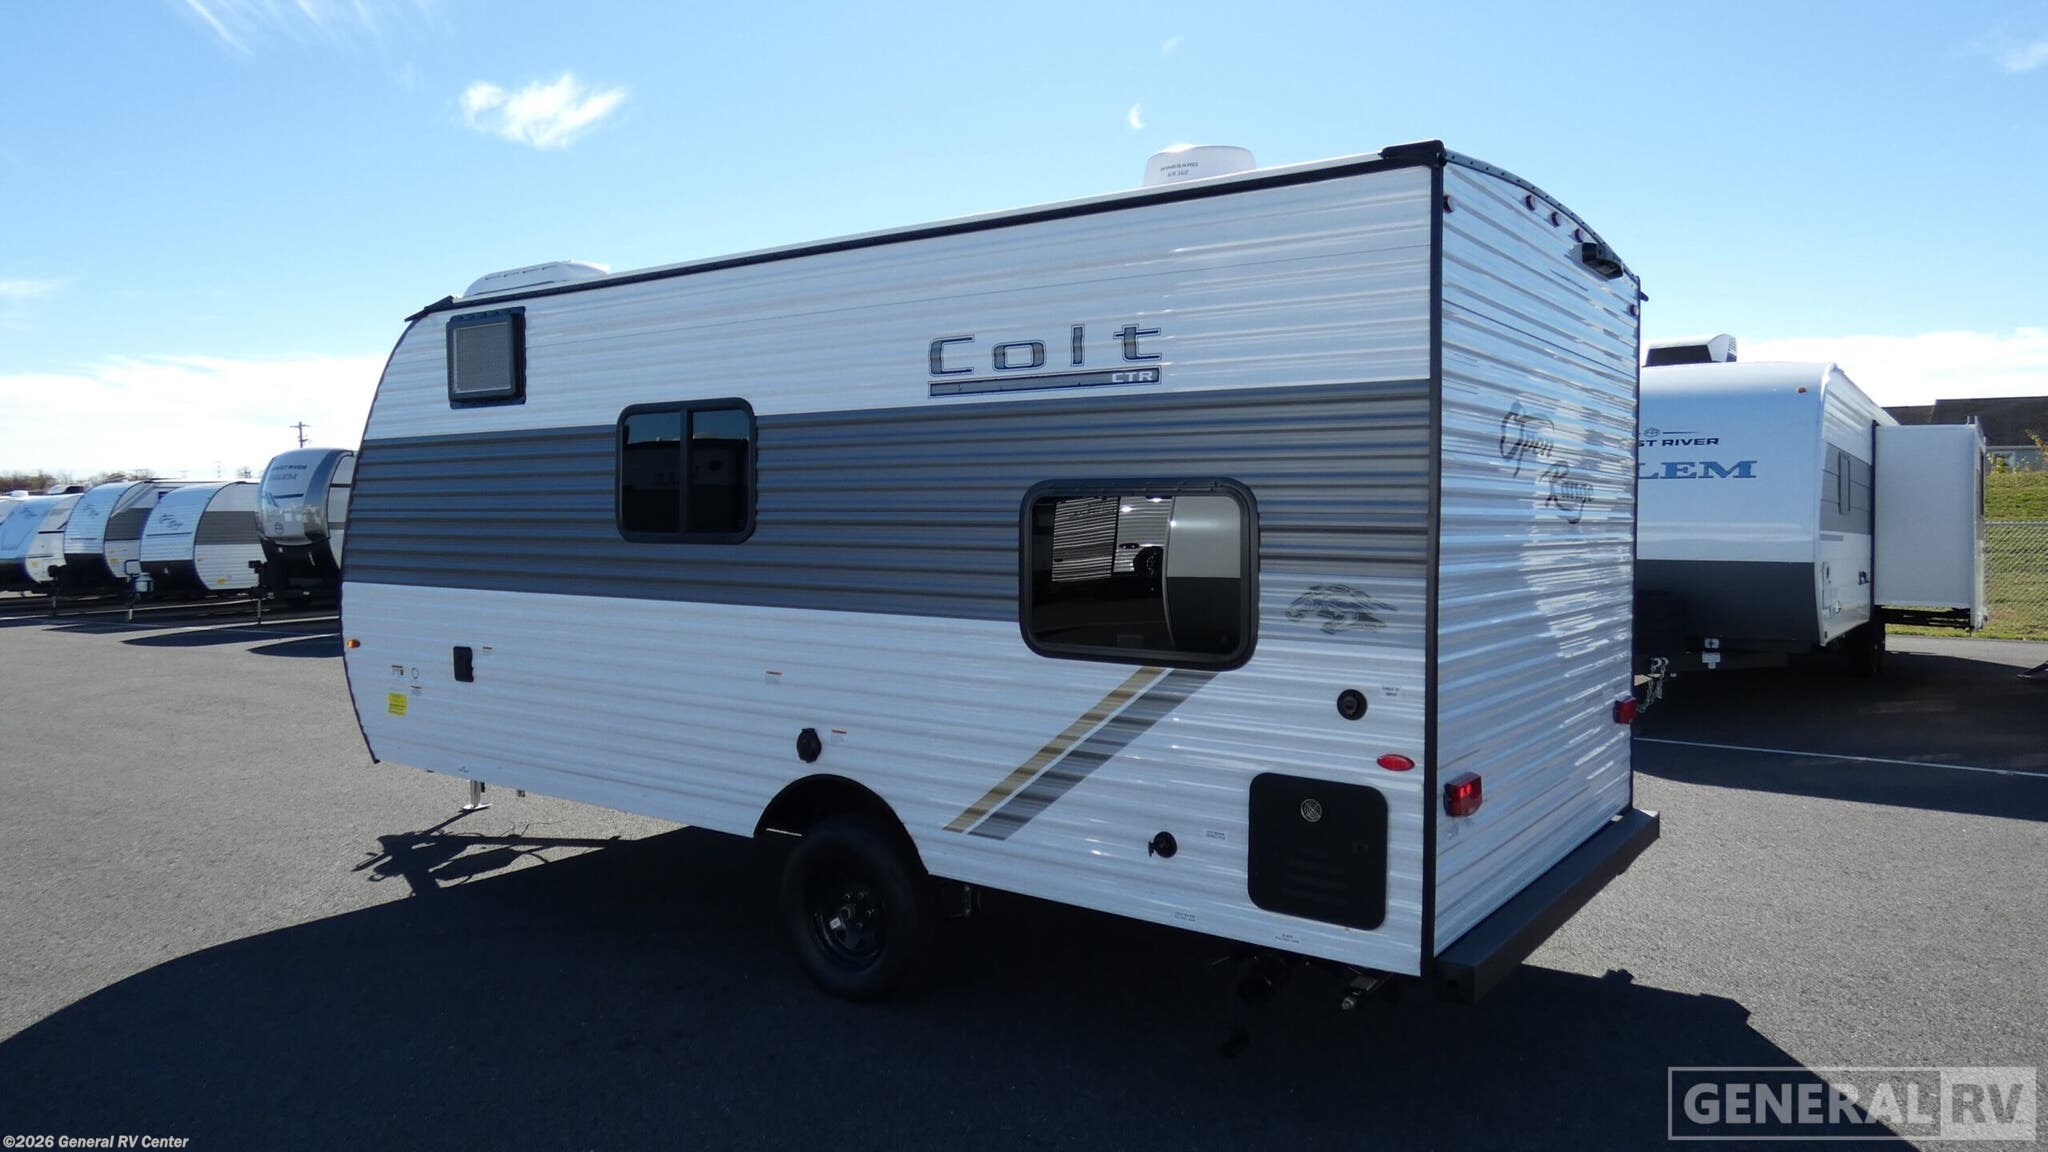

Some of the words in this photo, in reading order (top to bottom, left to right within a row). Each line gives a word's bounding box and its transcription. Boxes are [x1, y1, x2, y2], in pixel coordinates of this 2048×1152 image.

[928, 323, 1161, 377] Colt
[1112, 370, 1154, 383] CTR
[1500, 401, 1555, 477] Open
[1662, 438, 1719, 446] RIVER
[1540, 461, 1594, 524] Range
